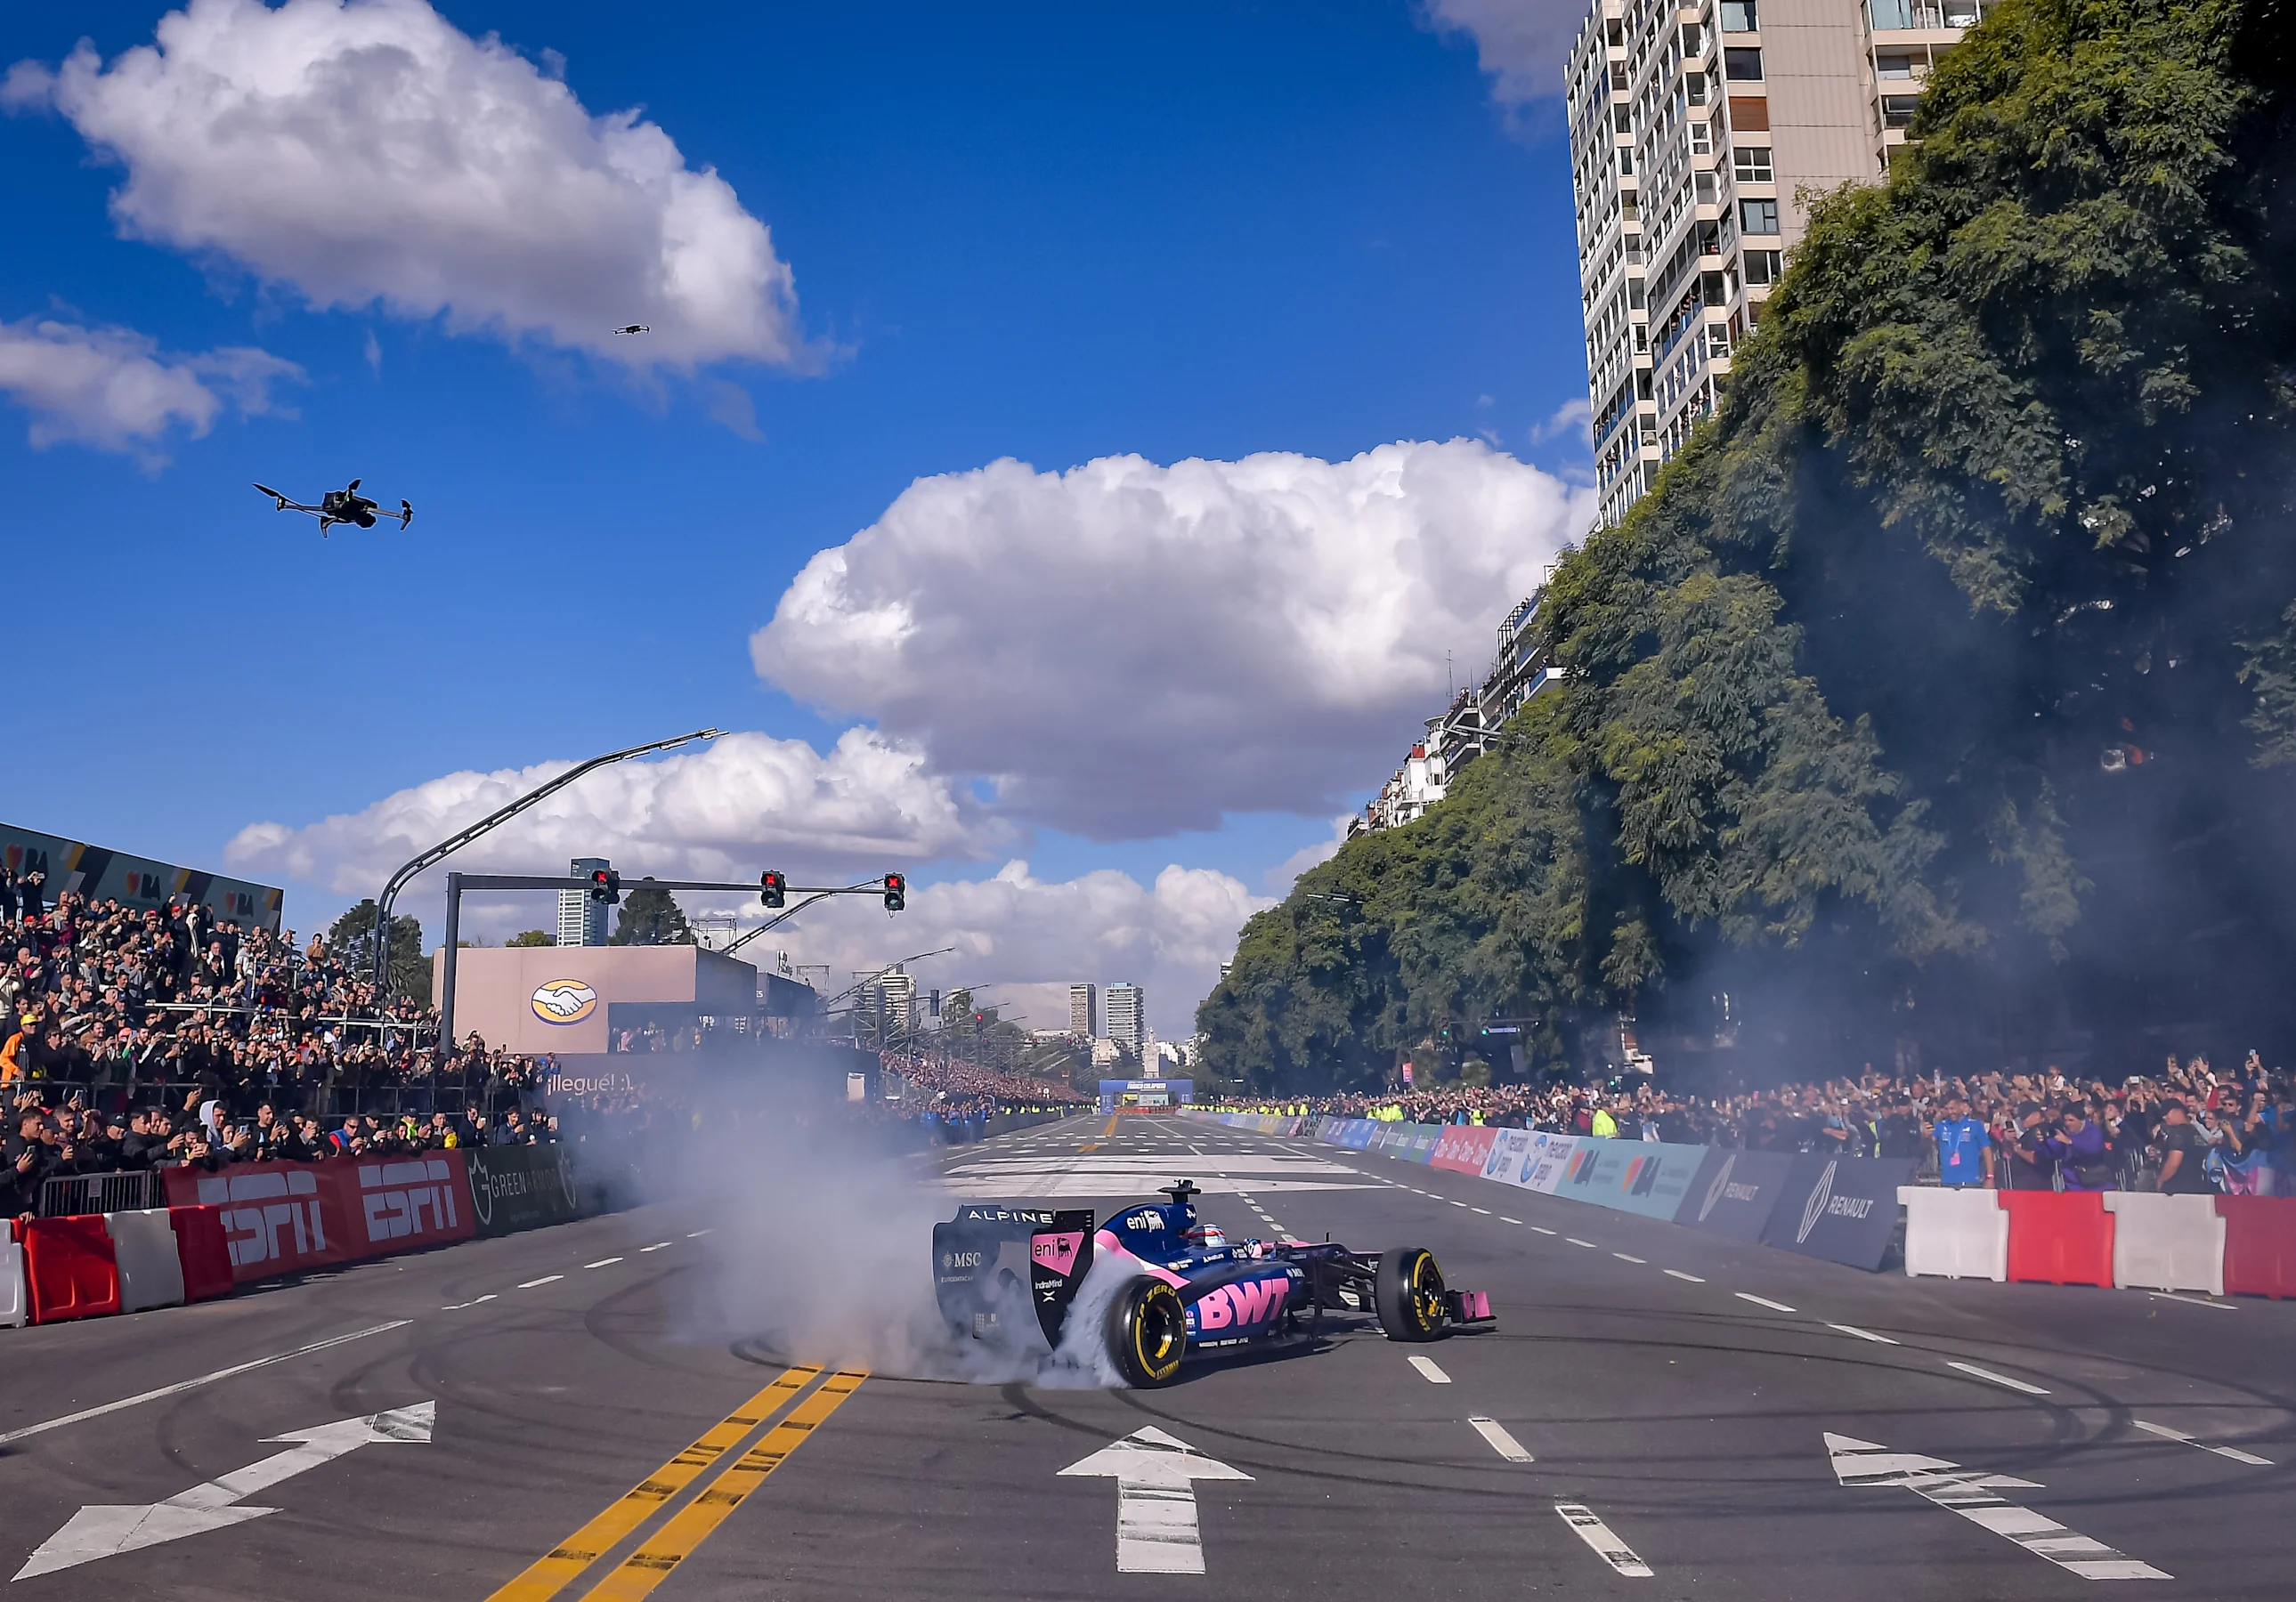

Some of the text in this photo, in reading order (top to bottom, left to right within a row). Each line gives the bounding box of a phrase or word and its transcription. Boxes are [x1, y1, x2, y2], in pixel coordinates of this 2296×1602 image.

[548, 1073, 614, 1096] ¡llegué!
[359, 1160, 458, 1242] ESPN
[1828, 1195, 1874, 1219] RENAULT
[197, 1170, 327, 1266] ESPN
[969, 1210, 1054, 1225] ALPINE
[1127, 1211, 1147, 1230] eni
[1034, 1239, 1055, 1257] eni
[954, 1252, 981, 1267] MSC
[1146, 1284, 1176, 1303] ZERO
[1197, 1277, 1290, 1331] BWT
